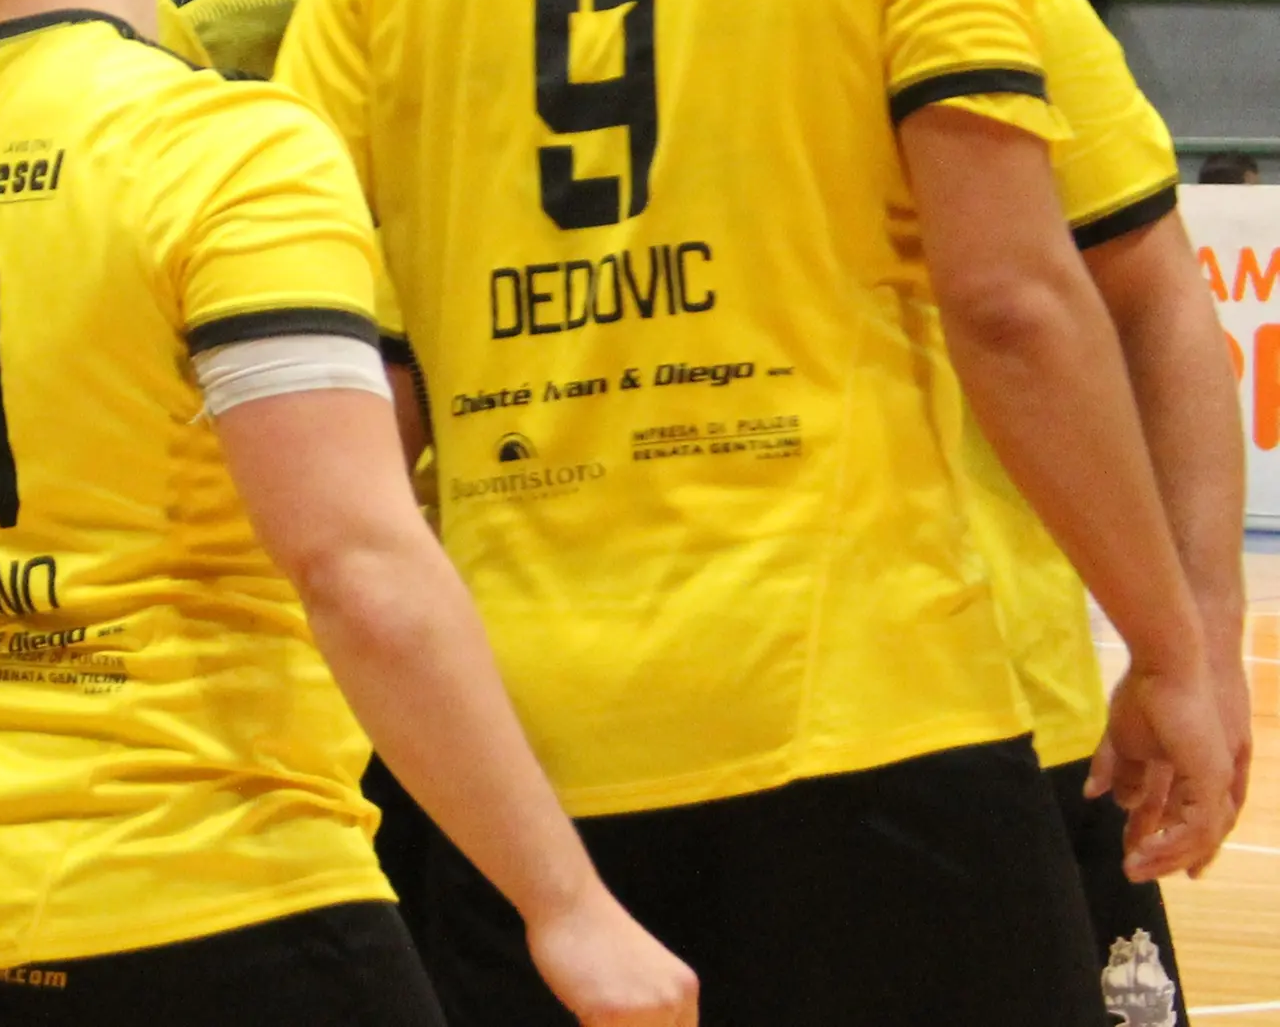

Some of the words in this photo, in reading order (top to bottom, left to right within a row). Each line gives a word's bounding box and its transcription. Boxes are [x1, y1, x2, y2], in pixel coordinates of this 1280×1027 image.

[490, 240, 717, 341] DEDOVIC
[619, 367, 641, 392] &
[654, 360, 756, 387] Diego
